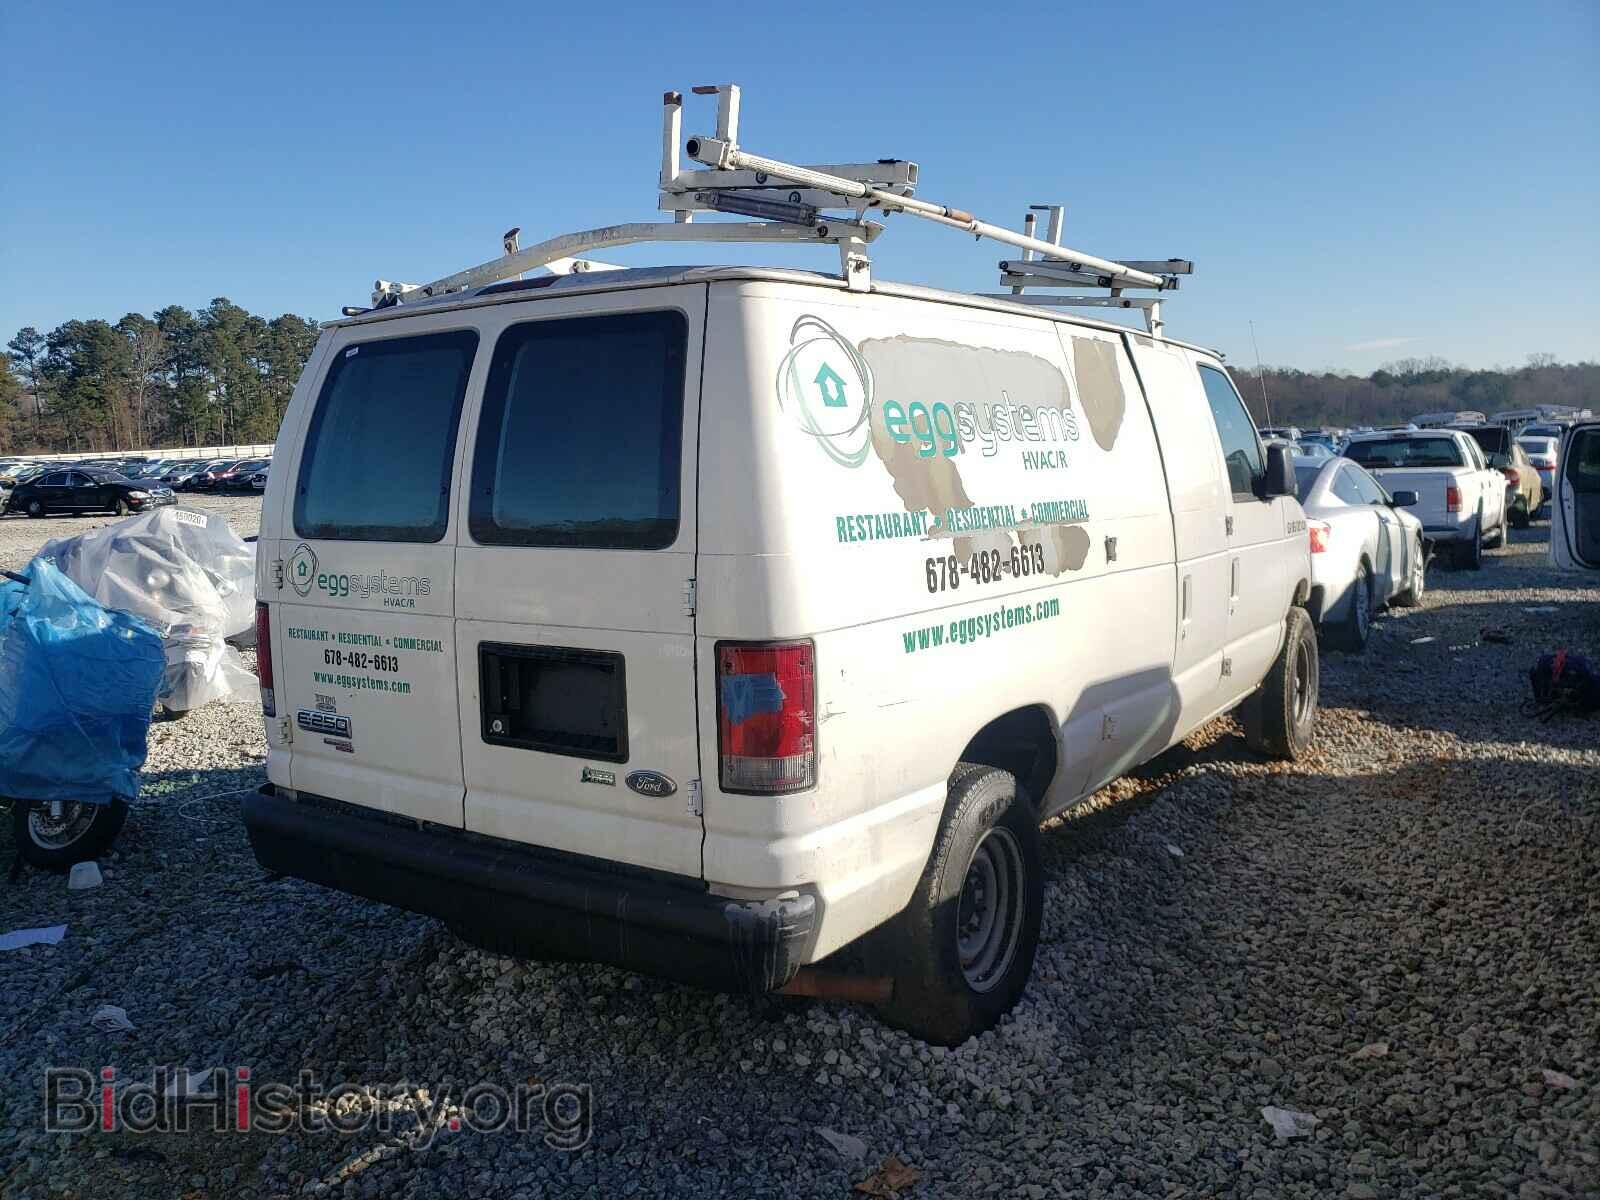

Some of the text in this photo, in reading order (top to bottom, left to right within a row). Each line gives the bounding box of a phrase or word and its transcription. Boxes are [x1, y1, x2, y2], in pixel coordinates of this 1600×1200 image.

[883, 390, 1081, 459] eggsystems
[1022, 450, 1069, 471] HVAC/R
[836, 499, 1090, 543] RESTAURANT RESIDENTIAL COMMERCIAL
[925, 543, 1046, 594] 678-482-6613
[317, 569, 432, 599] eggsystems
[383, 598, 416, 608] HVAC/R
[902, 597, 1060, 654] www.eggsystems.com
[288, 627, 444, 652] RESTAURANT RESIDENTIAL COMMERCIAL
[324, 649, 399, 673] 678-482-6613
[313, 671, 412, 694] www.eggsystems.com
